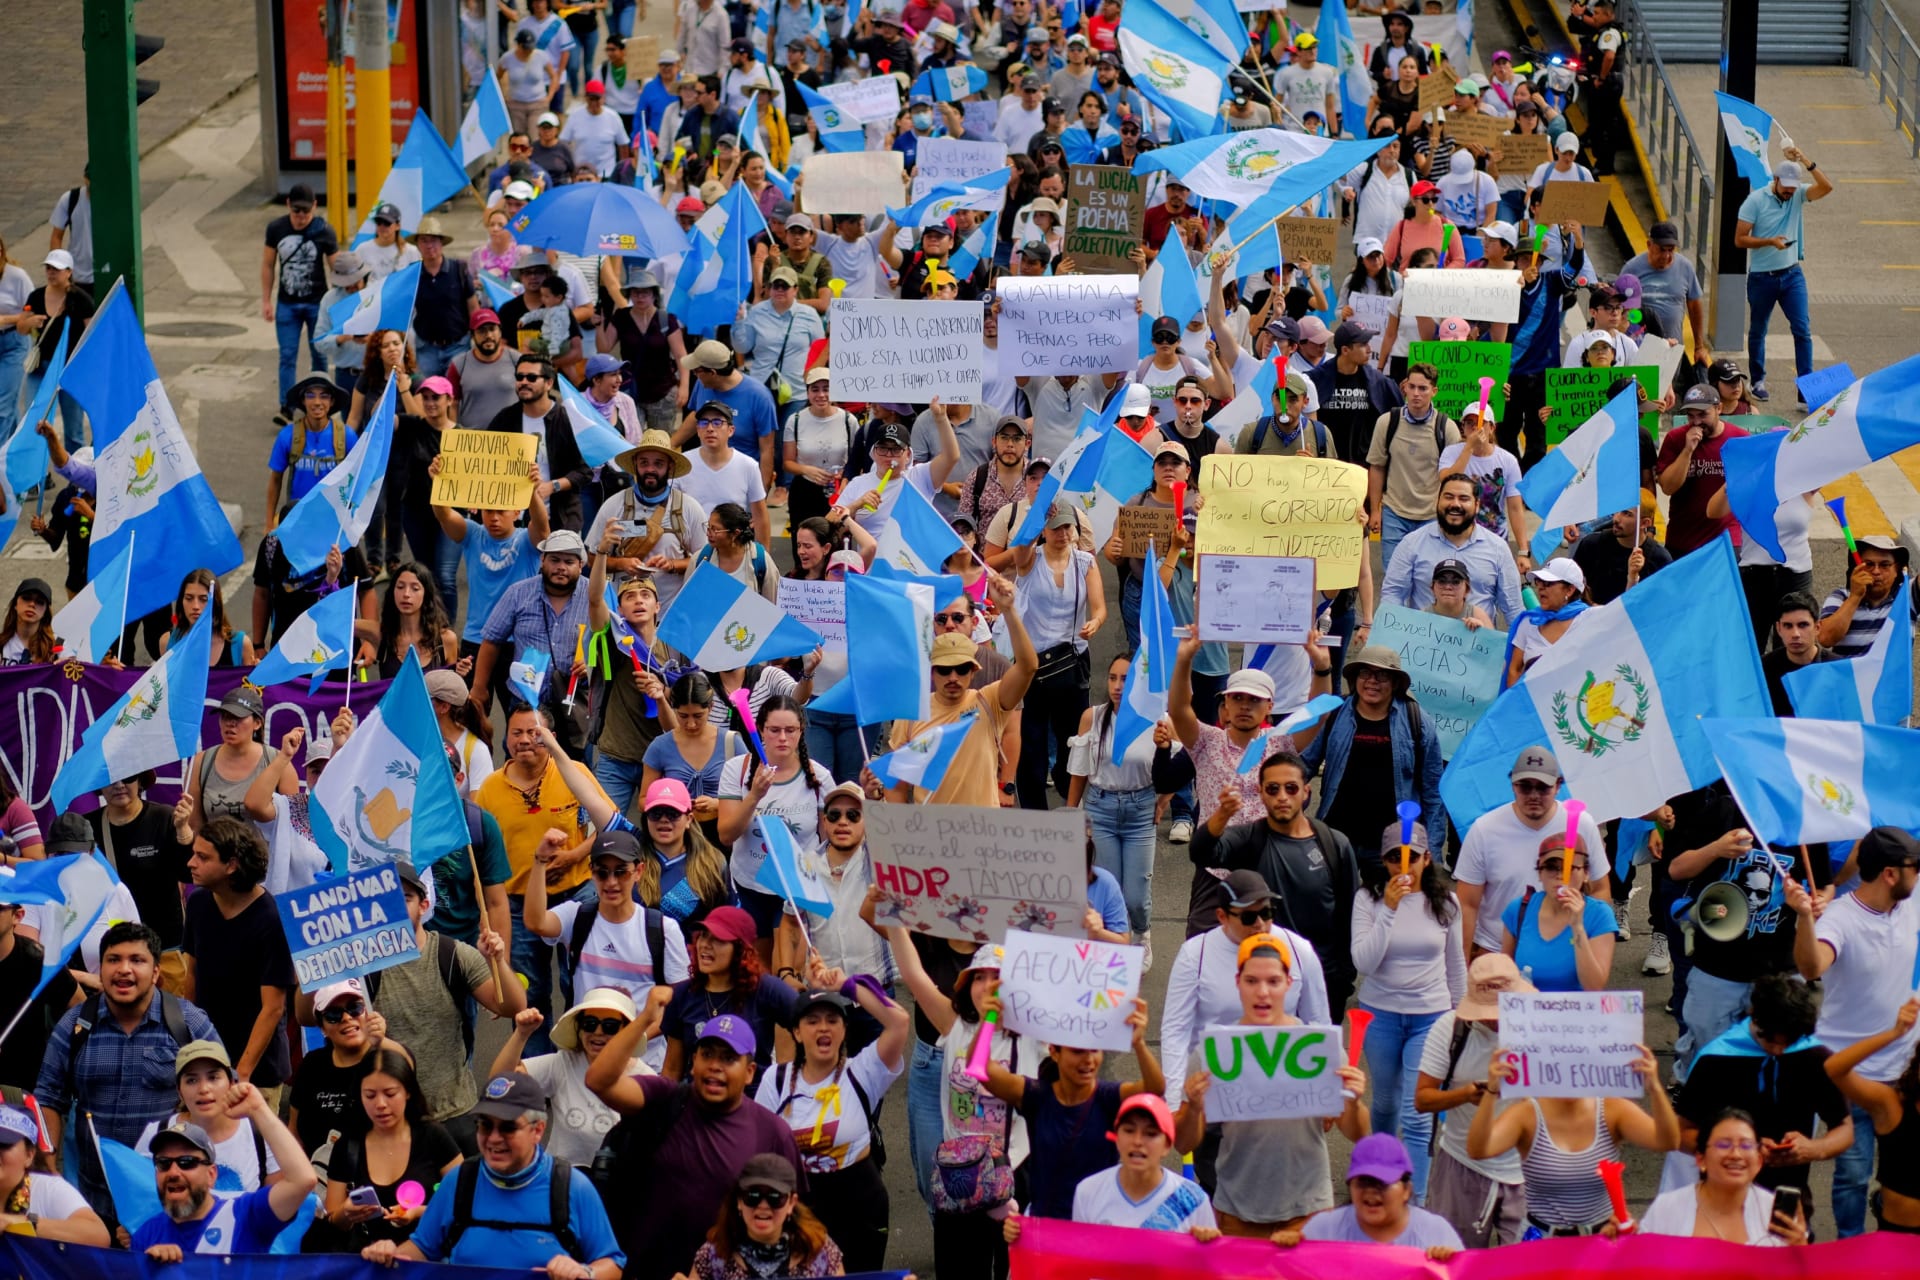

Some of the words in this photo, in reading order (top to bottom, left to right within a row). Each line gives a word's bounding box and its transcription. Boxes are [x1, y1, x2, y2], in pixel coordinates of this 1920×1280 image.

[1076, 170, 1095, 186] LA
[1098, 171, 1139, 194] LUCHA
[1089, 191, 1106, 206] ES
[1112, 194, 1129, 207] UN
[1077, 207, 1129, 232] POEMA
[1066, 235, 1137, 259] COLECTIVO
[1004, 284, 1128, 303] GUATEMALA
[841, 315, 887, 343] SOMOS
[893, 316, 912, 338] LA
[1005, 308, 1025, 321] UN
[1038, 309, 1095, 326] PUEBLO
[1099, 308, 1121, 322] SIN
[1016, 329, 1078, 347] PIERNAS
[1087, 332, 1122, 347] PERO
[834, 350, 867, 369] QUE
[1021, 351, 1050, 368] QUE
[1060, 354, 1112, 369] CAMINA
[1432, 345, 1471, 366] COVID
[1476, 352, 1504, 366] nos
[838, 376, 878, 393] POR
[937, 369, 952, 384] DE
[463, 457, 500, 475] VALLE
[1211, 461, 1254, 489] NO
[1267, 466, 1290, 494] hay
[1303, 464, 1351, 489] PAZ
[438, 479, 459, 502] EN
[467, 480, 485, 504] LA
[487, 481, 519, 506] CALLE
[1119, 506, 1131, 517] No
[1133, 510, 1159, 520] puedo
[1242, 502, 1252, 521] el
[1260, 497, 1358, 525] CORRUPTO
[1246, 536, 1255, 553] el
[1263, 534, 1361, 559] INDIFERENTE
[1383, 612, 1463, 647] Devuelvan
[1471, 636, 1490, 655] las
[1400, 642, 1467, 677] ACTAS
[1462, 685, 1475, 707] la
[905, 811, 928, 835] el
[937, 813, 997, 840] pueblo
[1003, 825, 1025, 838] no
[941, 837, 965, 858] el
[974, 844, 1057, 867] gobierno
[874, 862, 949, 898] HDP
[960, 867, 1073, 899] TAMPOCO
[301, 910, 352, 946] CON
[352, 901, 388, 930] LA
[295, 927, 417, 985] DEMOCRACIA
[1010, 949, 1109, 991] AEUVG
[1008, 990, 1108, 1038] Presente
[1533, 999, 1582, 1012] maestra
[1601, 994, 1645, 1014] KINDER
[1204, 1030, 1327, 1082] UVG
[1598, 1042, 1639, 1054] votar
[1538, 1061, 1562, 1085] LOS
[1570, 1063, 1643, 1090] ESCUCHEN
[1216, 1082, 1335, 1118] Presente
